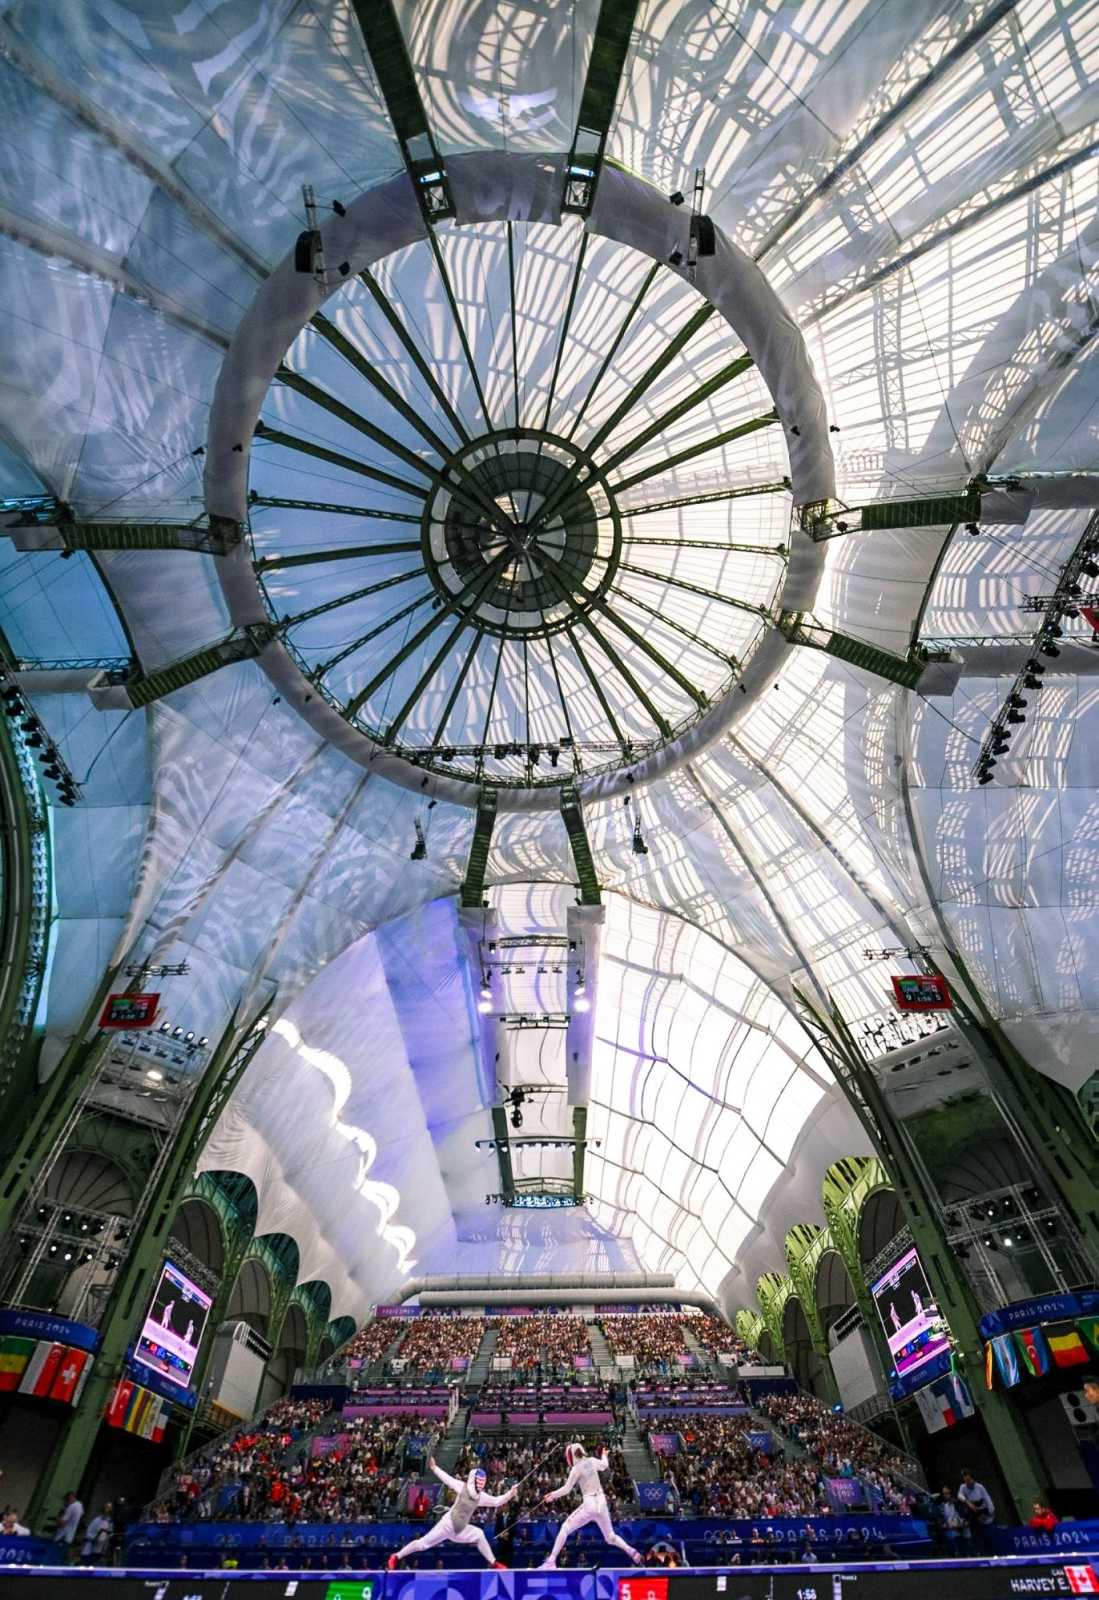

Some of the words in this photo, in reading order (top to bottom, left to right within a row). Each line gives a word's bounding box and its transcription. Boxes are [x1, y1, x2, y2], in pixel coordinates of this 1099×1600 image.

[1008, 1306, 1036, 1320] PARIS
[1037, 1302, 1065, 1314] 2024
[775, 1529, 828, 1542] PARS
[1013, 1534, 1051, 1548] PARIS
[1055, 1530, 1090, 1546] 2024
[1010, 1578, 1056, 1593] HARVEY
[1057, 1577, 1071, 1591] E.
